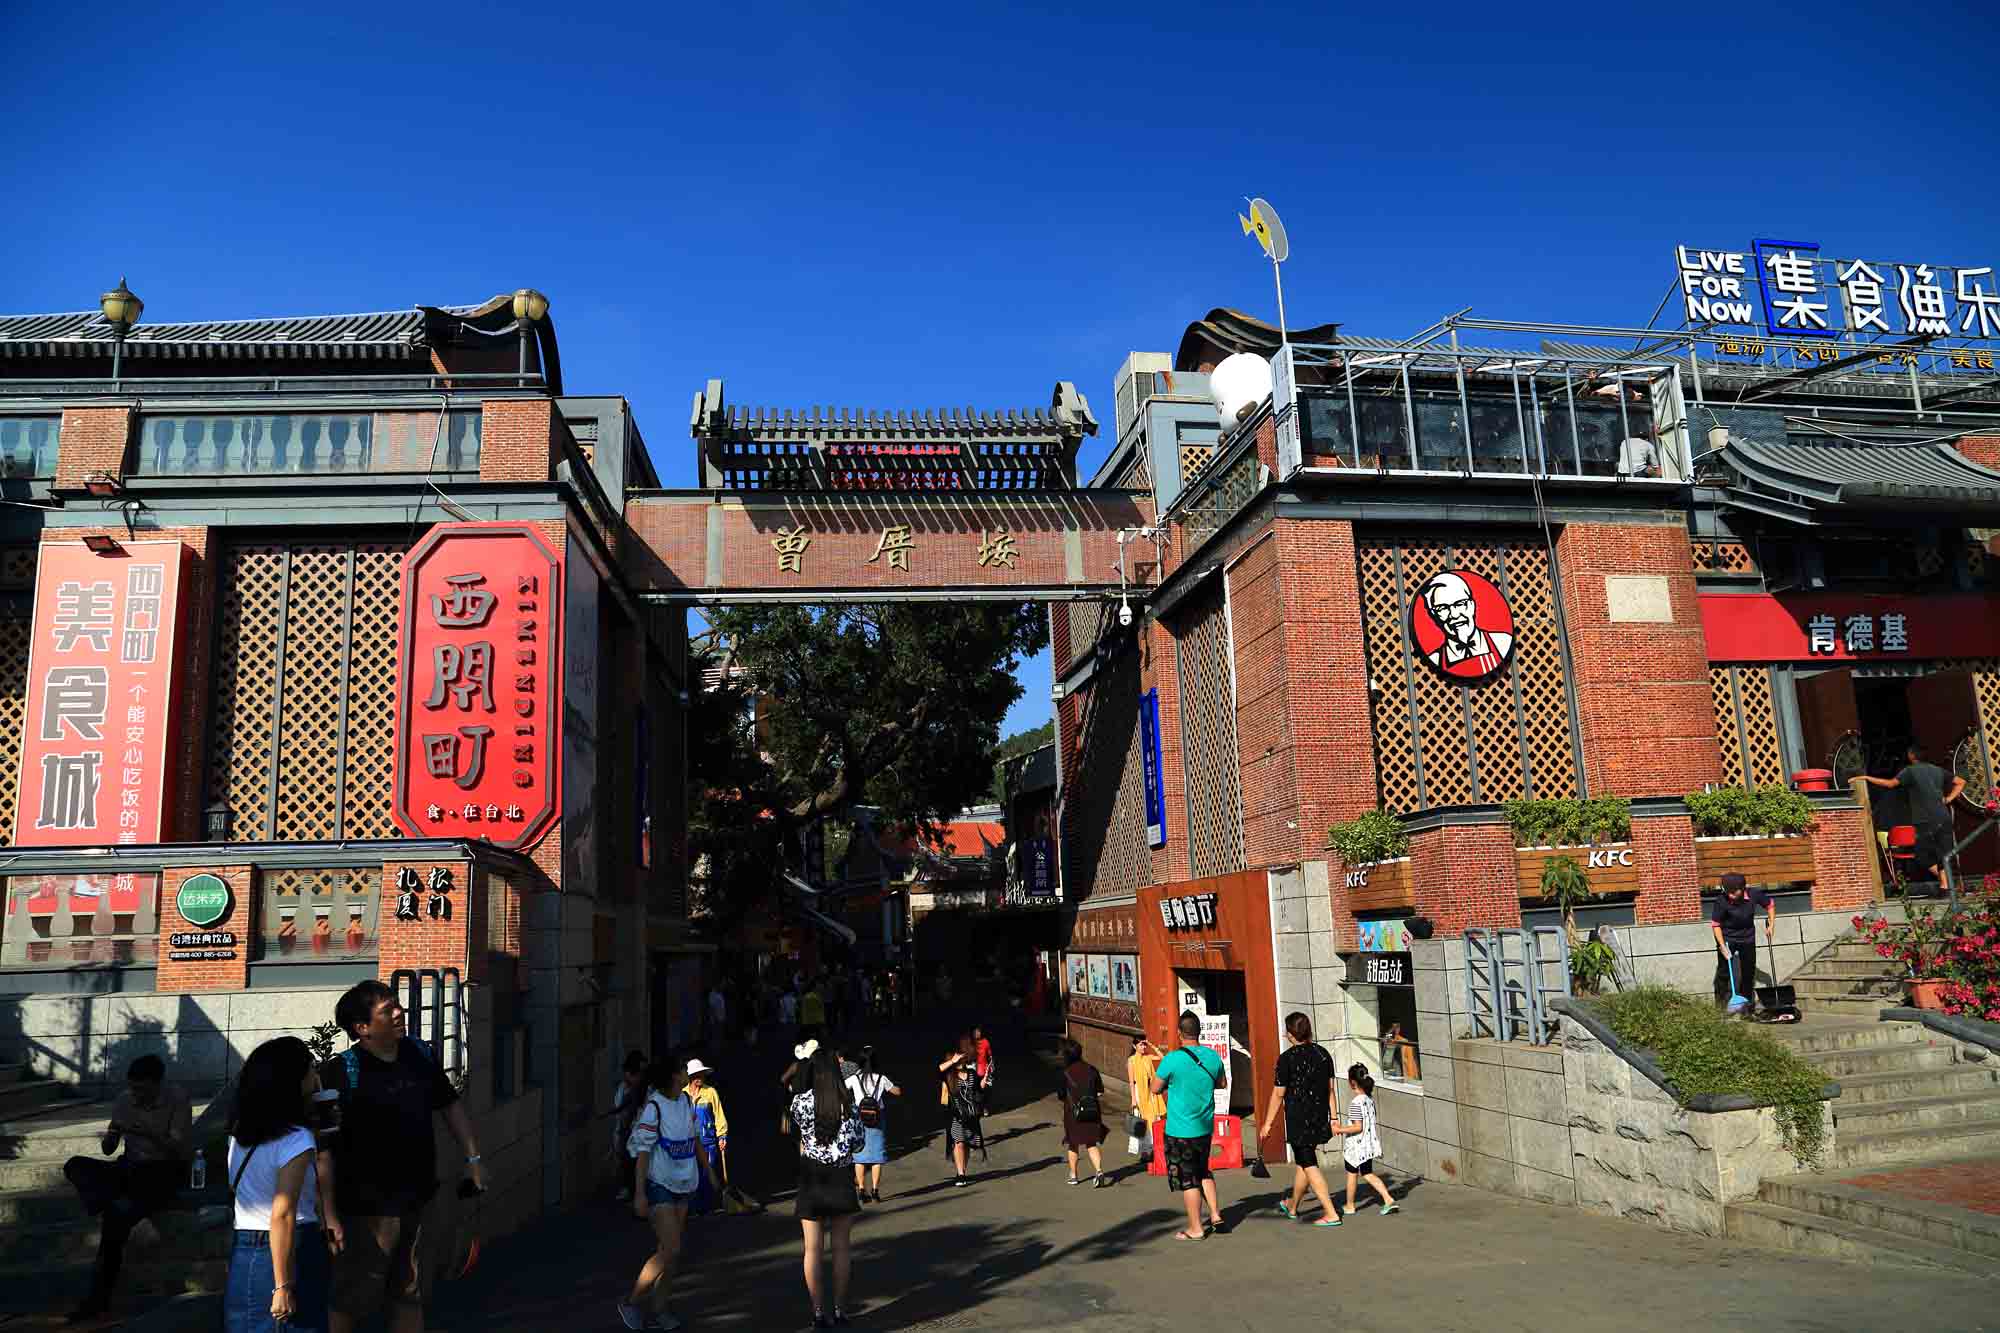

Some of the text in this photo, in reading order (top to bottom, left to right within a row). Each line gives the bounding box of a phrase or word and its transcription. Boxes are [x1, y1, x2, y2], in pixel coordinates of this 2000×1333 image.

[1677, 245, 1746, 275] LIVE
[1683, 271, 1742, 298] FOR
[1688, 295, 1752, 324] NOW
[1808, 613, 1909, 653] 肯德基
[35, 580, 115, 831] 美食城
[1588, 850, 1633, 868] KFC
[1346, 871, 1369, 888] KFC
[396, 892, 445, 916] 厦门
[1367, 959, 1403, 984] 甜品站
